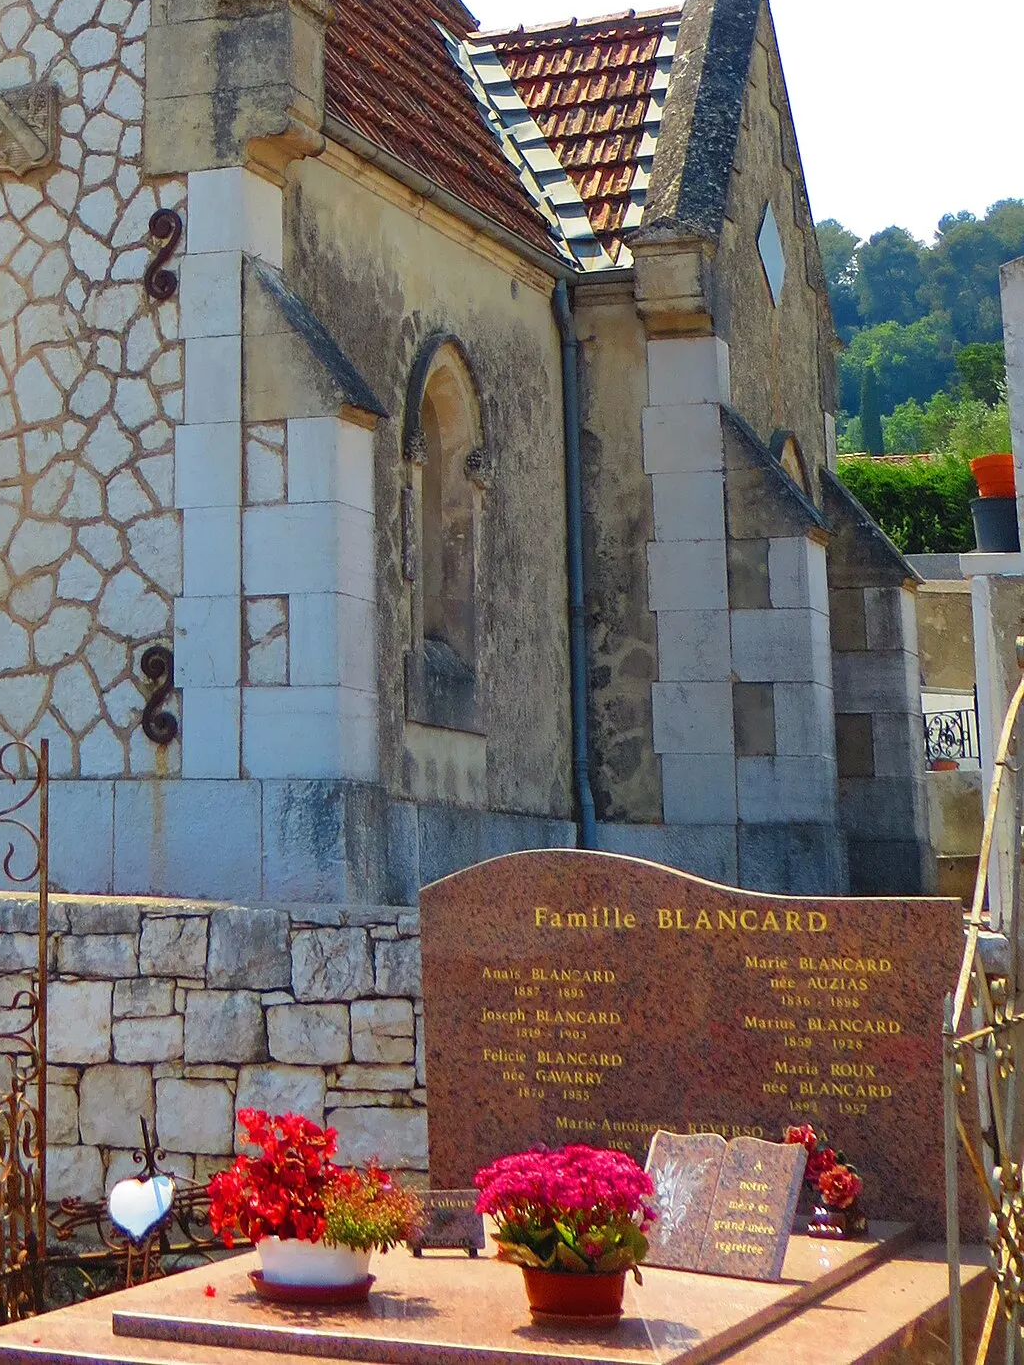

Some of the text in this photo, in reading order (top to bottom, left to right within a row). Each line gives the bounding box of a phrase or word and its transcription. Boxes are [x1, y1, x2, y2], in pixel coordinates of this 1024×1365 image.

[534, 907, 828, 932] Famille BLANCARD
[745, 956, 893, 972] Marie BLANCARD
[531, 968, 616, 984] BLANCARD
[808, 977, 869, 991] AUZIAS
[536, 1009, 621, 1025] BLANCARD
[744, 1016, 901, 1034] Marius BLANCARD
[537, 1050, 623, 1067] BLANCARD
[535, 1070, 604, 1084] GAVARRY
[775, 1061, 876, 1078] Maria ROUX
[799, 1081, 892, 1098] BLANCARD
[688, 1122, 764, 1138] REVERSO
